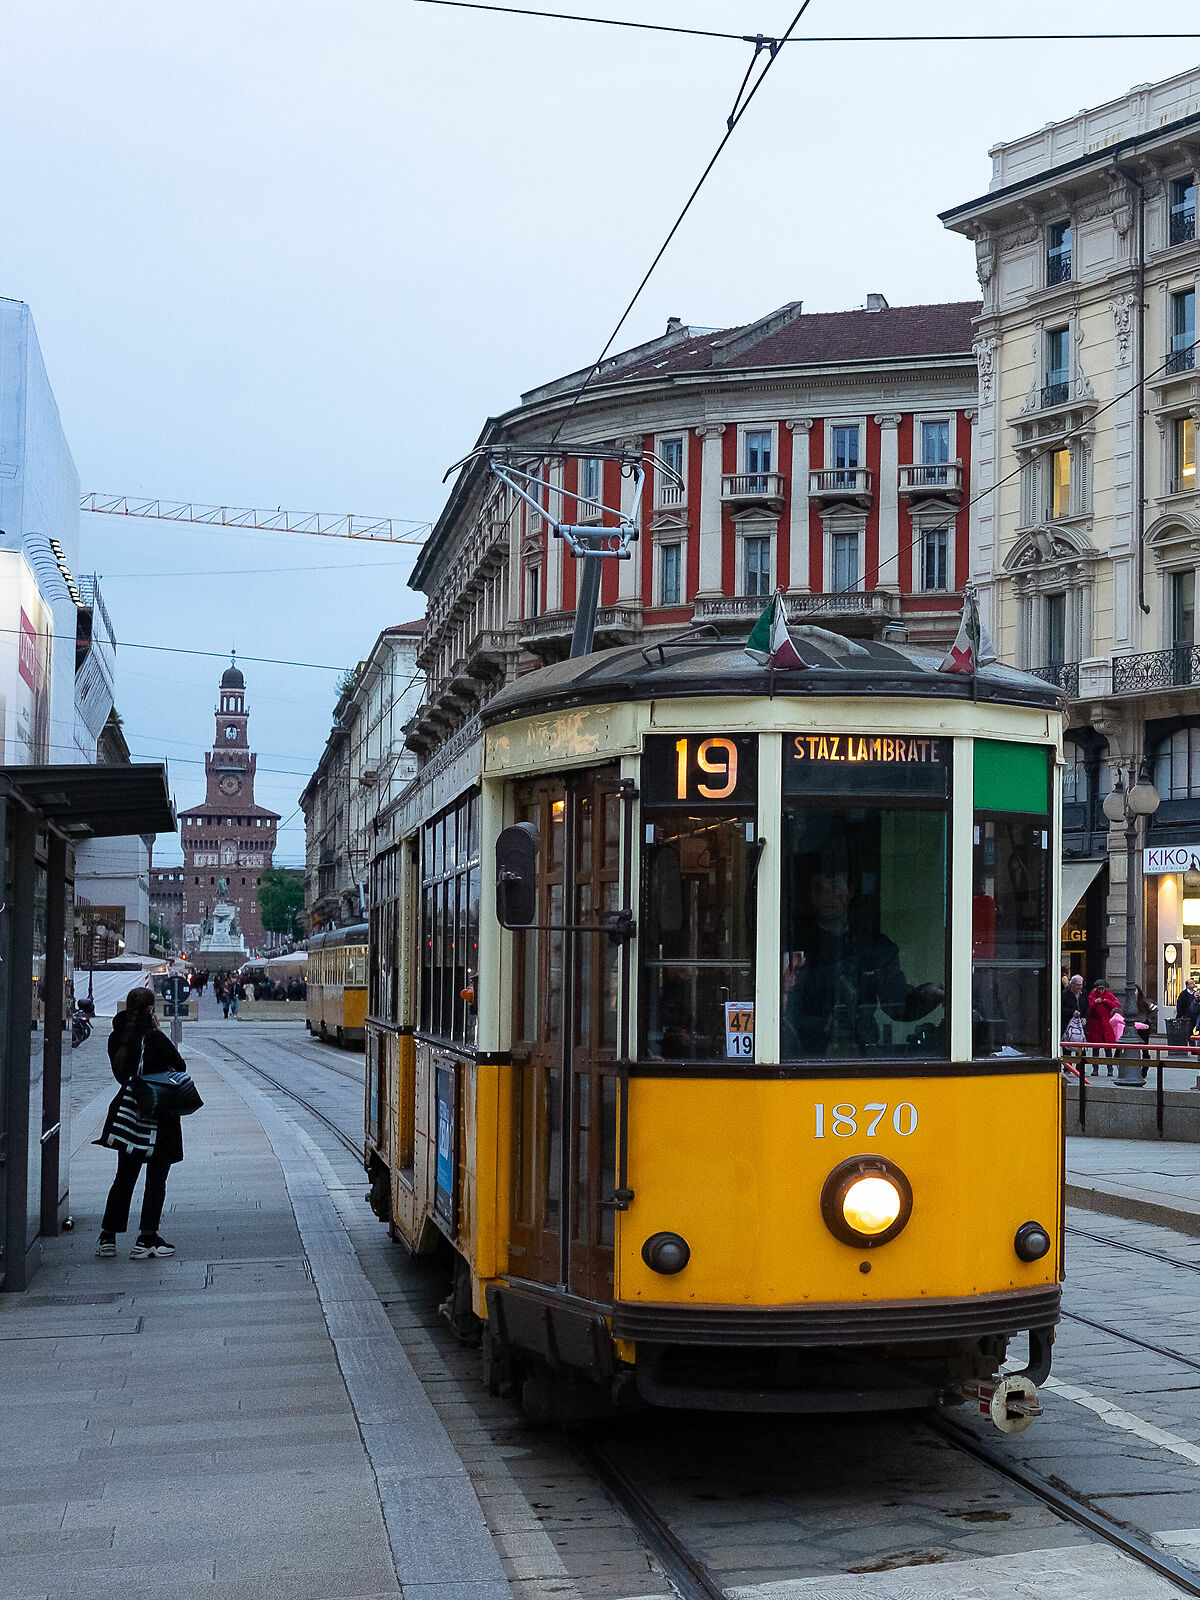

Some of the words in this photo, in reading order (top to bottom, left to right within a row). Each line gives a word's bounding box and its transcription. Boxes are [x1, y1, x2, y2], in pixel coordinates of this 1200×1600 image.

[793, 736, 845, 761] STAZ.
[848, 737, 940, 763] LAMBRATE
[676, 737, 738, 800] 19
[1148, 848, 1188, 867] KIKO
[730, 1012, 752, 1032] 47
[732, 1035, 753, 1055] 19
[814, 1101, 919, 1138] 1870
